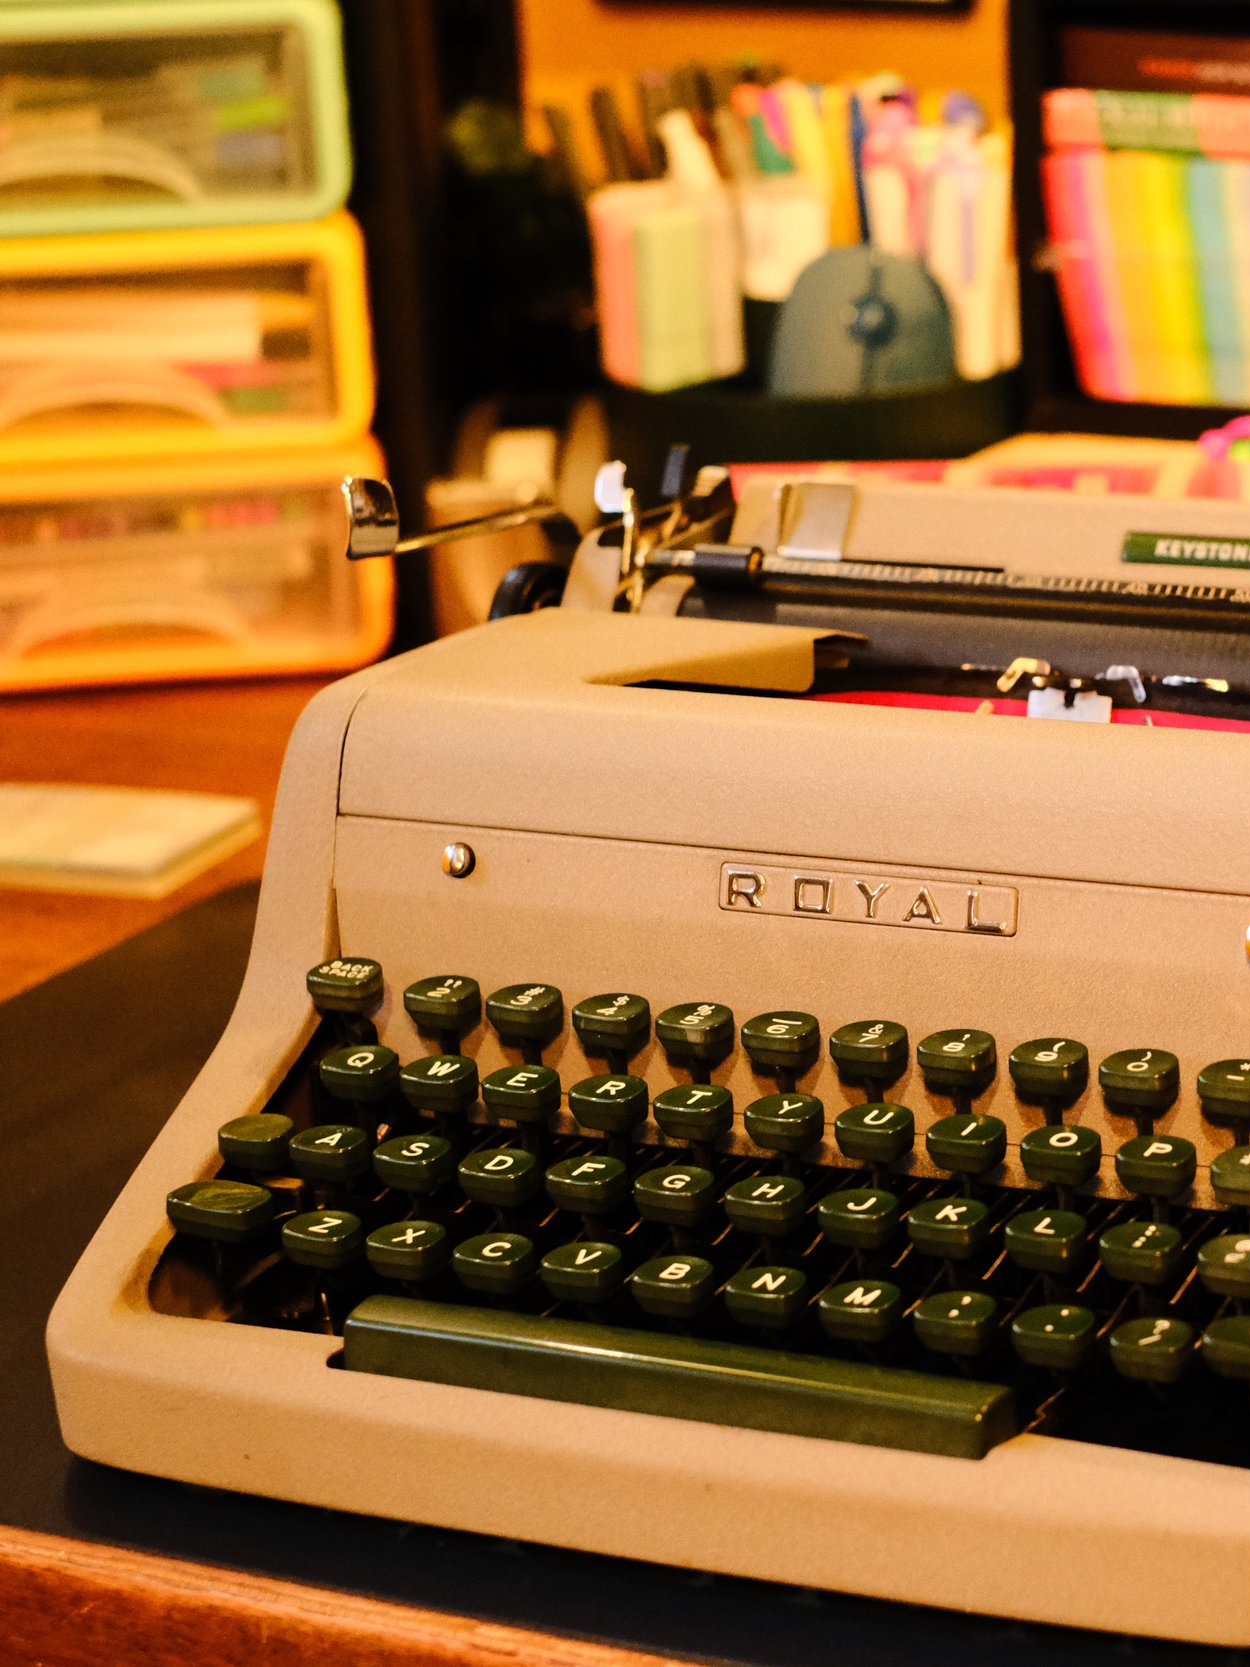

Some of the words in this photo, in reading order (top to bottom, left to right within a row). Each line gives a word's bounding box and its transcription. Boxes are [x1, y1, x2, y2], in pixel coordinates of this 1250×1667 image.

[727, 868, 1008, 933] ROYAL
[319, 965, 370, 979] SPACE
[330, 960, 374, 973] BACK
[427, 987, 452, 998] 2
[510, 994, 533, 1006] 3
[596, 1004, 619, 1017] 4
[766, 1024, 789, 1035] 6
[942, 1041, 965, 1053] 8
[1034, 1051, 1058, 1062] 9
[346, 1052, 374, 1068] Q
[426, 1061, 461, 1077] W
[506, 1072, 539, 1087] E
[595, 1080, 626, 1095] R
[686, 1090, 713, 1105] T
[778, 1100, 803, 1115] Y
[863, 1110, 895, 1125] U
[960, 1121, 978, 1136] I
[1049, 1132, 1078, 1148] O
[1143, 1142, 1173, 1157] P
[314, 1132, 343, 1147] A
[401, 1142, 430, 1157] S
[484, 1155, 514, 1170] D
[571, 1162, 606, 1176] F
[662, 1174, 692, 1189] G
[751, 1183, 785, 1198] H
[846, 1196, 877, 1211] J
[935, 1205, 968, 1222] K
[1033, 1217, 1055, 1234] L
[308, 1217, 343, 1234] Z
[391, 1228, 426, 1244] X
[481, 1241, 512, 1257] C
[574, 1249, 603, 1265] V
[658, 1263, 691, 1280] B
[751, 1273, 787, 1291] N
[843, 1287, 882, 1306] M
